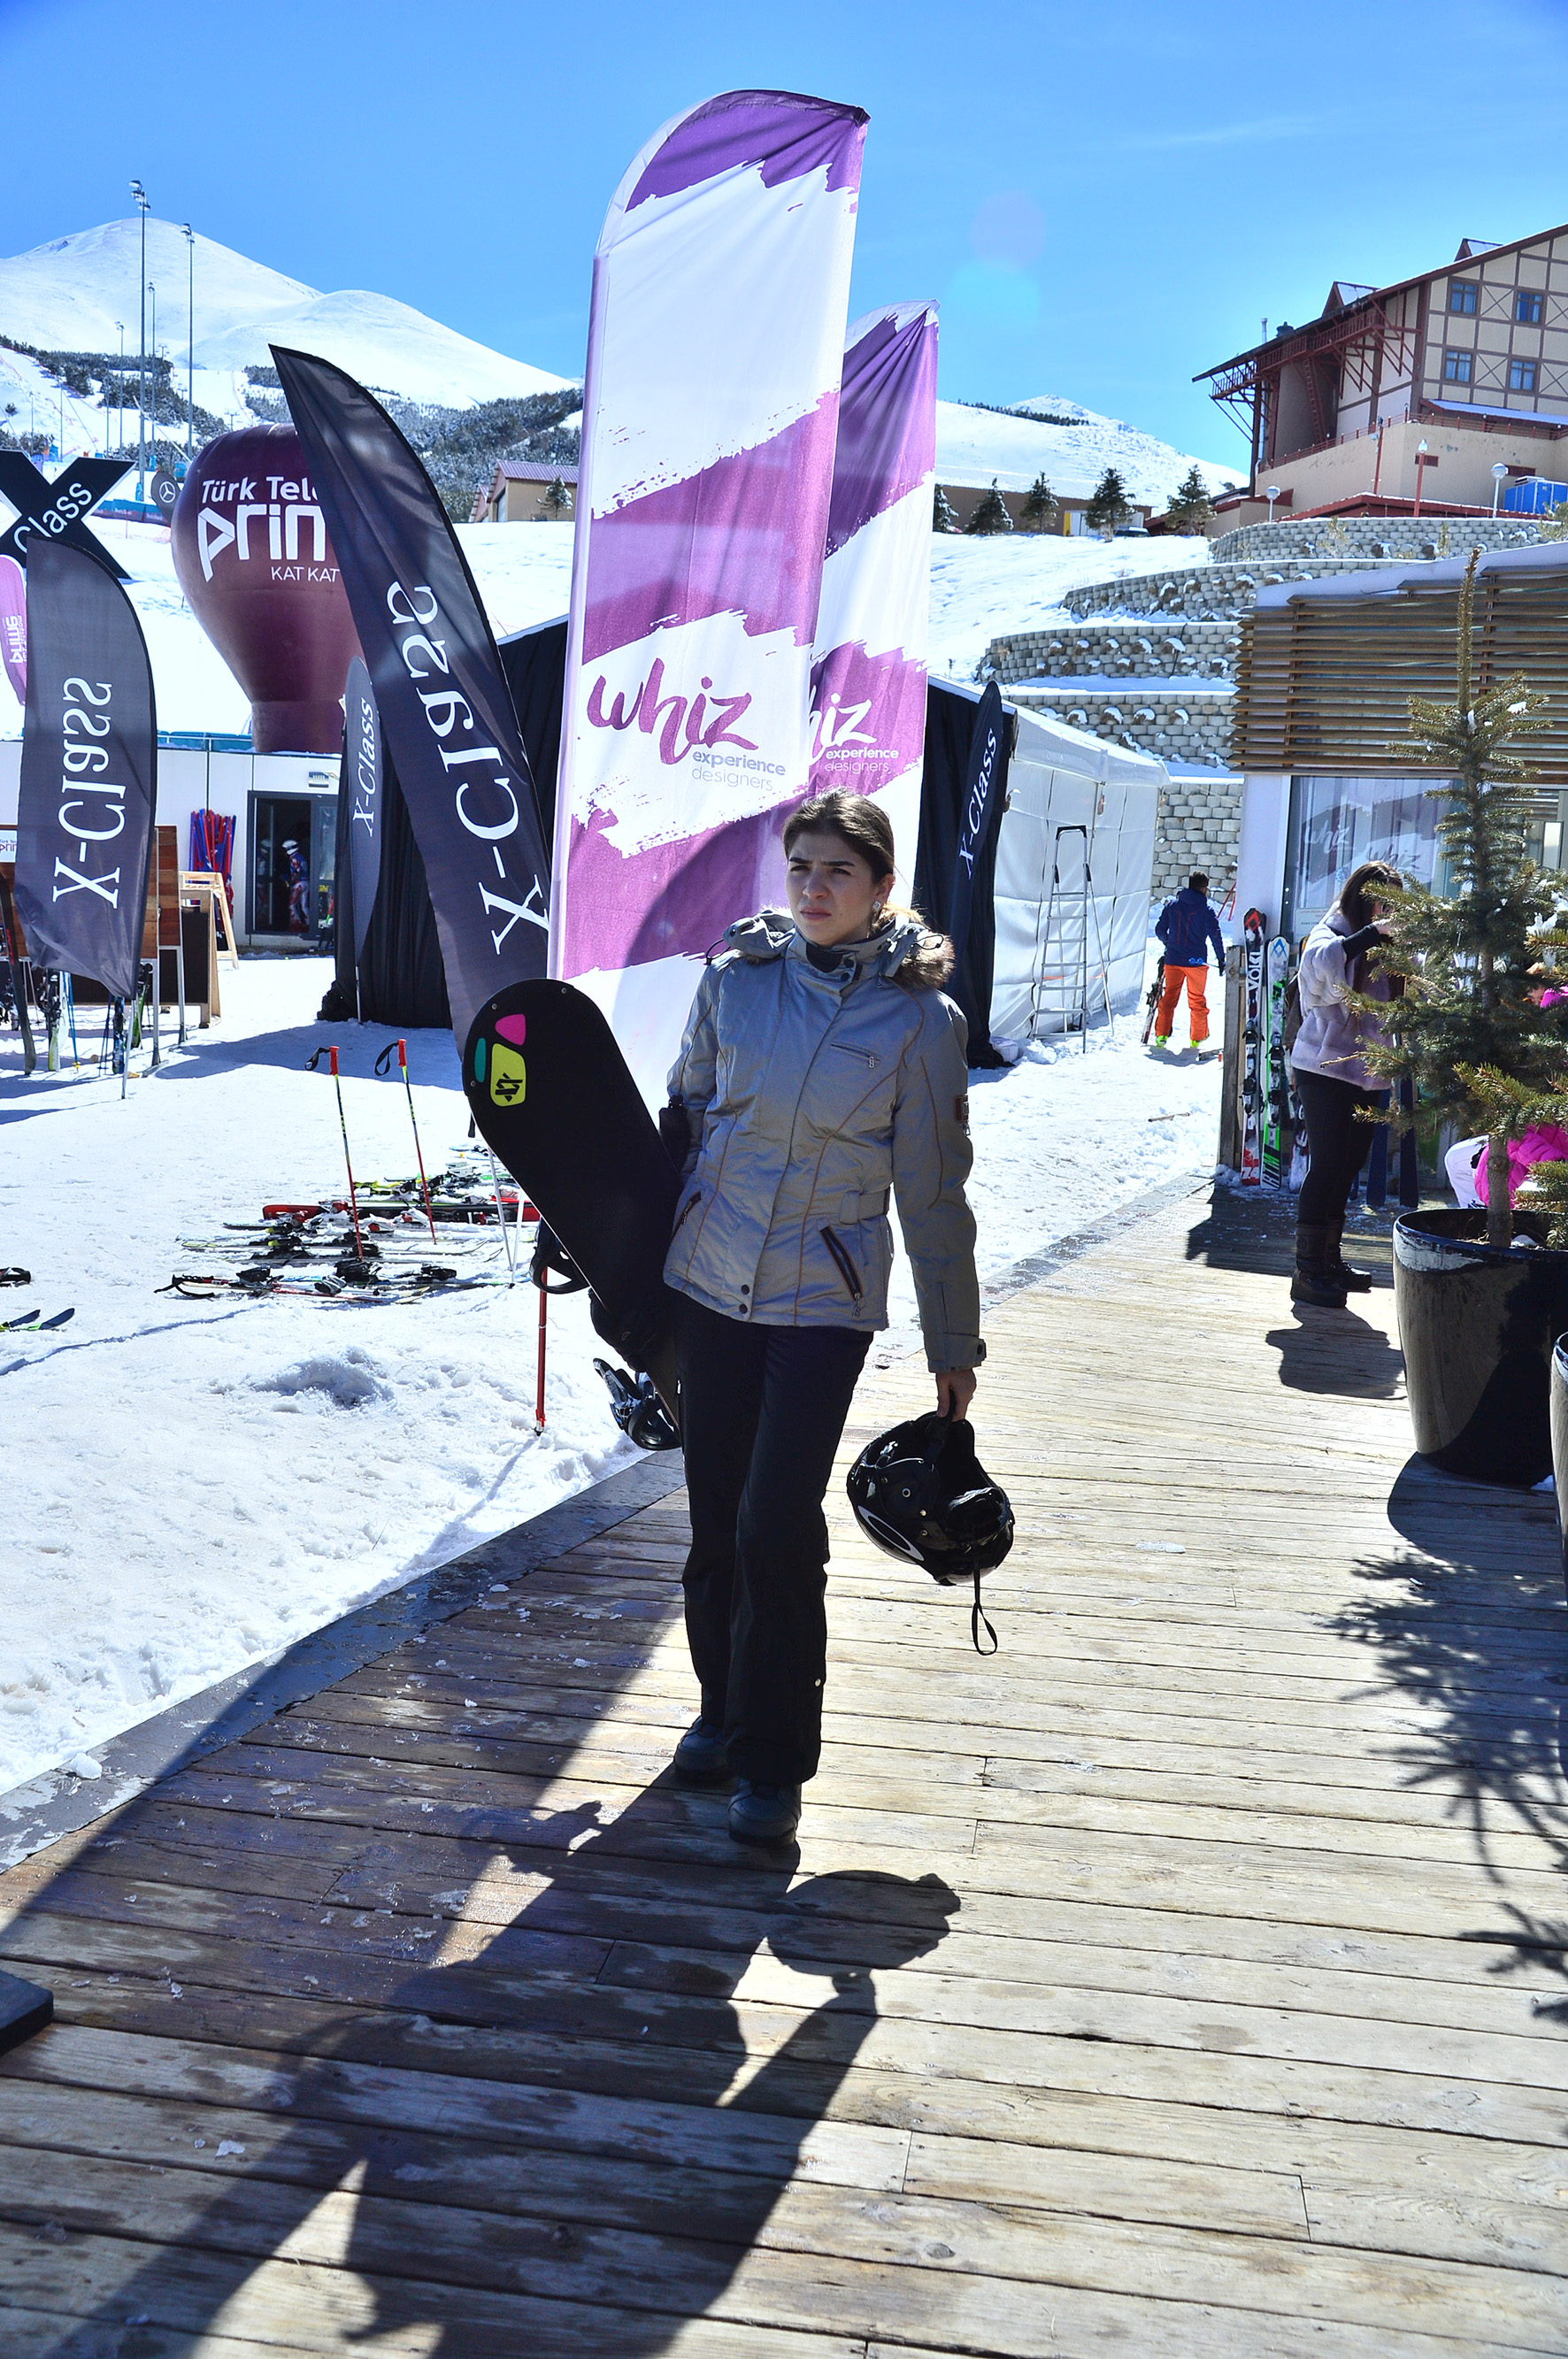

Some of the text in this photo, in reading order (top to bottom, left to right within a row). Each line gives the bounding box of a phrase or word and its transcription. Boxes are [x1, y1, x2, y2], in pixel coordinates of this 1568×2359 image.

[202, 476, 318, 503] Türk Tel
[13, 482, 92, 553] Class
[271, 566, 340, 582] KAT KAT
[587, 657, 759, 765] whiz
[809, 685, 877, 767] hiz
[353, 697, 376, 837] X-Class
[692, 751, 786, 775] experience
[825, 761, 889, 774] designers
[826, 747, 899, 761] experience
[691, 765, 773, 791] designers
[959, 728, 996, 880] X-Class
